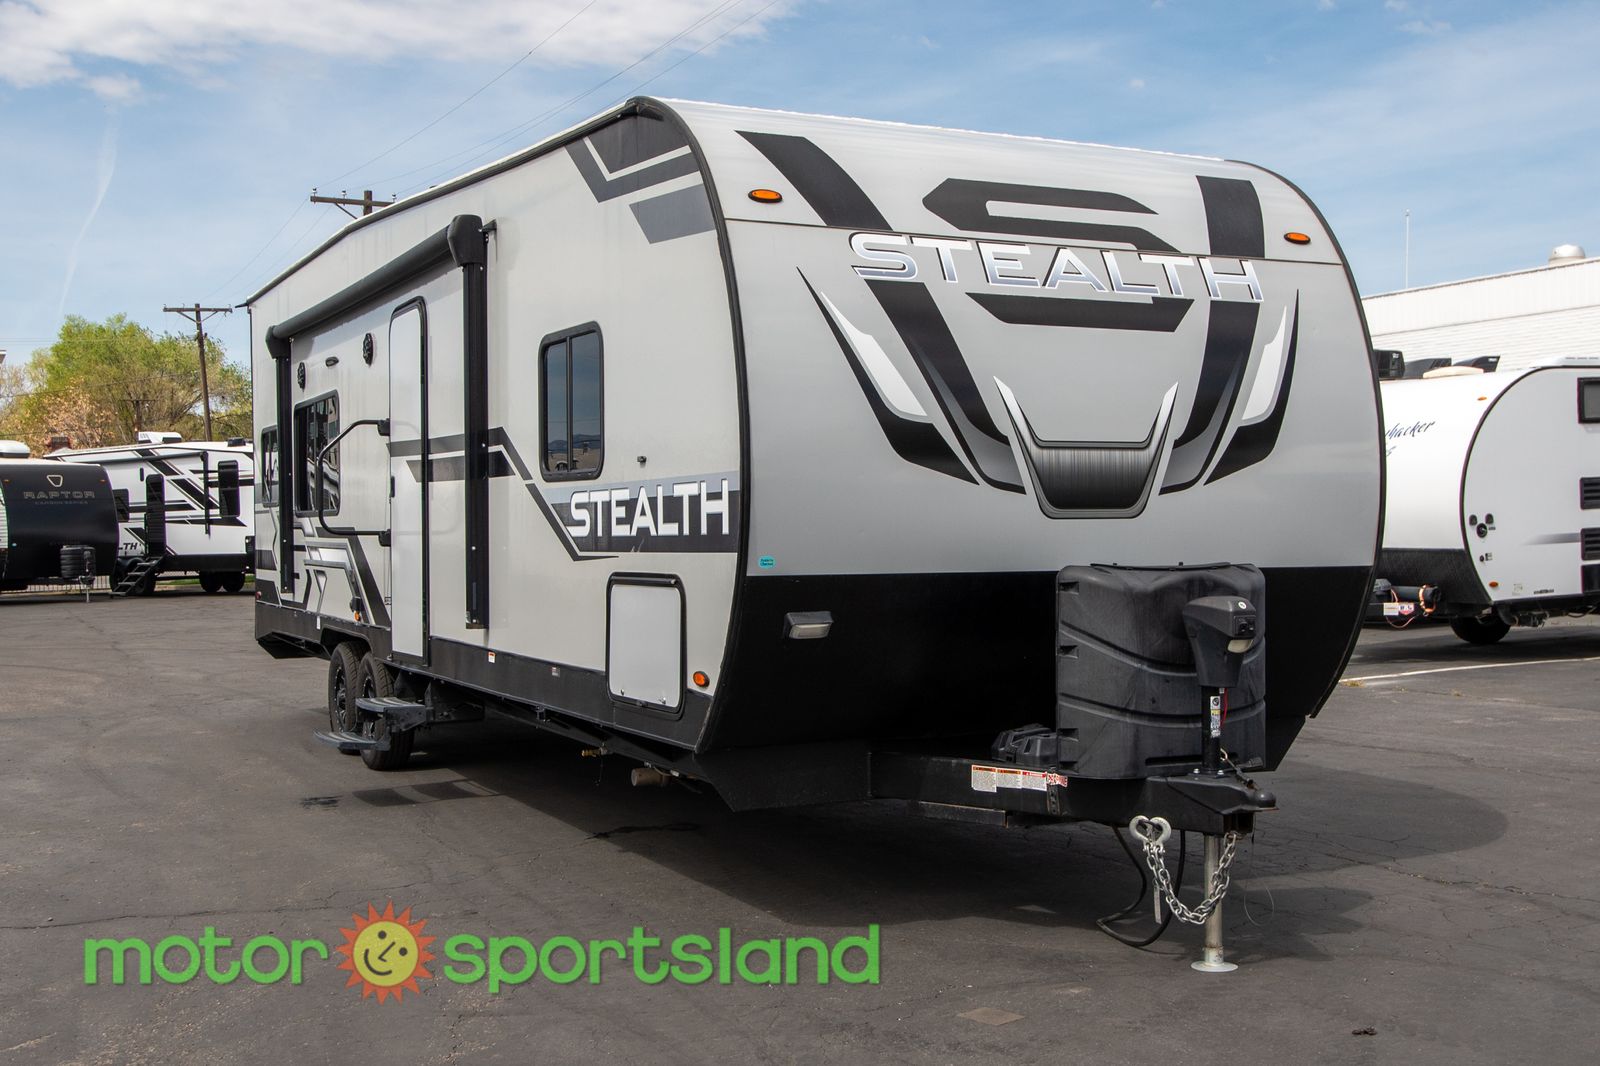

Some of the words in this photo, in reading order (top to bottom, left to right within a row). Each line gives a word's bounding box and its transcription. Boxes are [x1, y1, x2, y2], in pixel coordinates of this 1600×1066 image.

[849, 232, 1264, 303] STEALTH
[23, 491, 95, 499] RAPTOR
[566, 478, 730, 537] STEALTH
